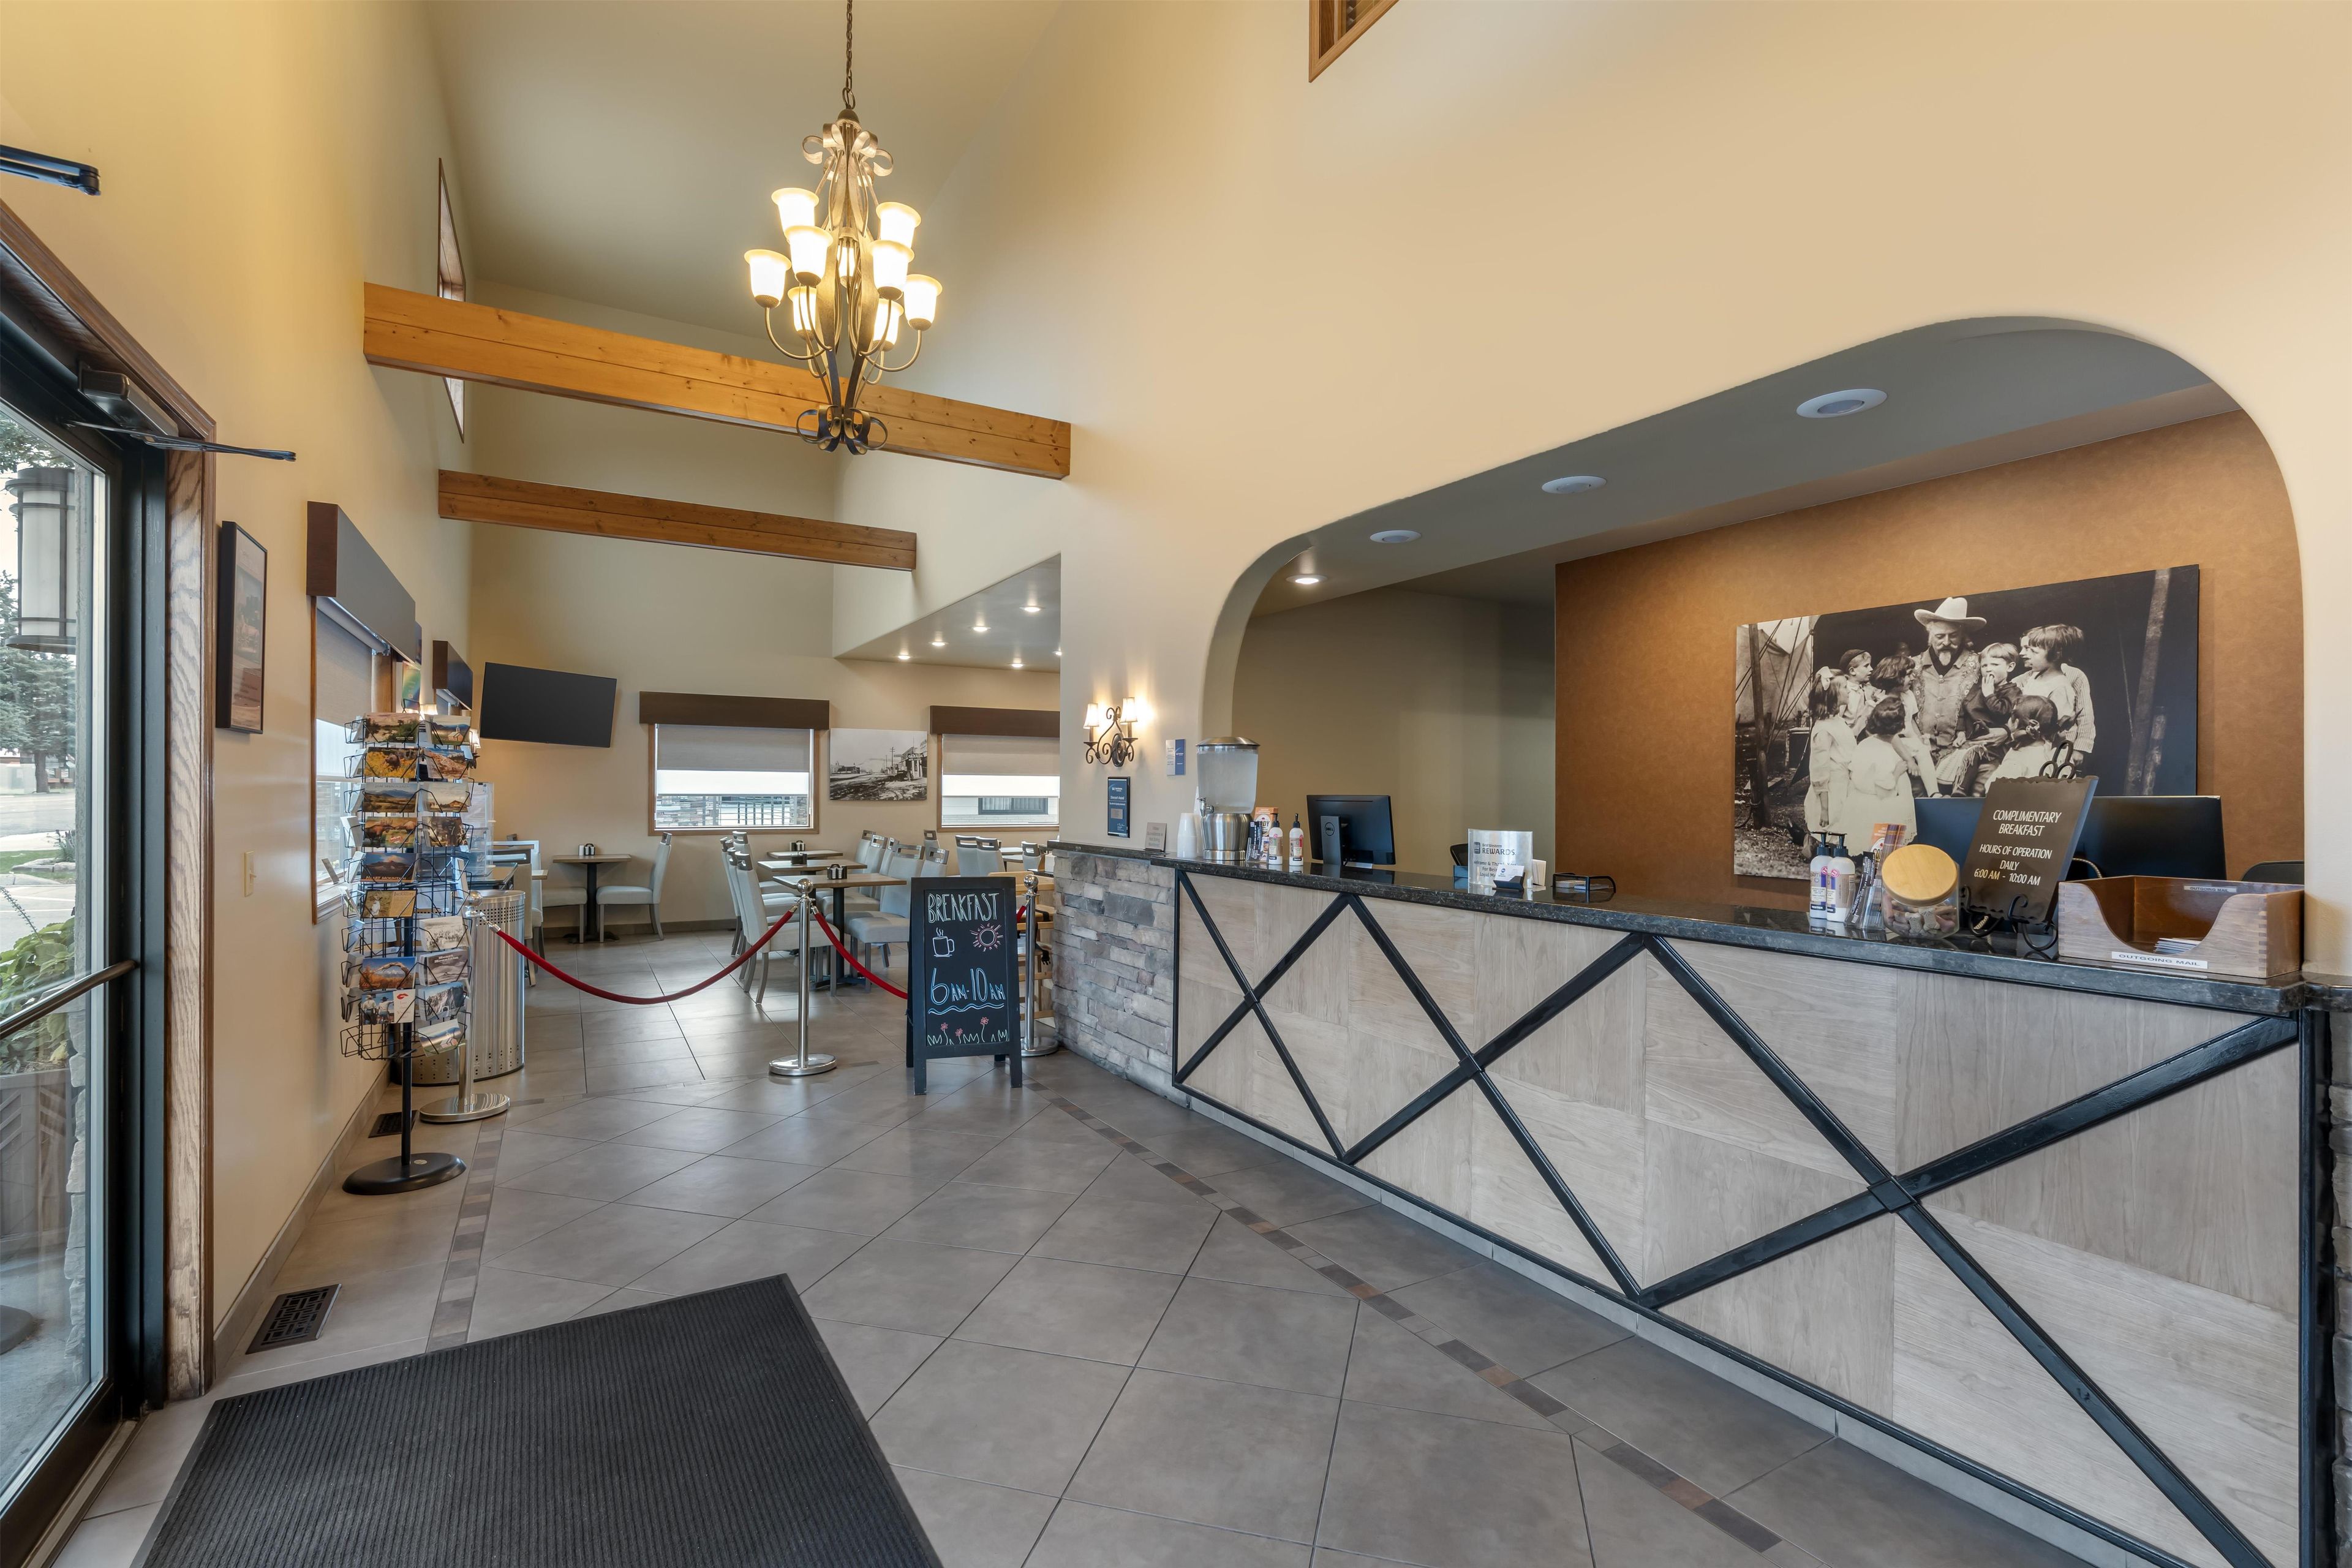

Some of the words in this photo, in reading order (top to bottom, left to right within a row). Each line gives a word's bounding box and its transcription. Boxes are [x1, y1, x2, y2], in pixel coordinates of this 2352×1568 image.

[1993, 809, 2062, 823] COMPLIMENTARY
[1999, 823, 2045, 837] BREAKFAST
[1980, 843, 2001, 855] HOURS
[2002, 846, 2012, 855] OF
[2013, 846, 2052, 859] OPERATION
[2000, 860, 2019, 870] DAILY
[1974, 869, 1988, 878] 6:00
[1988, 870, 2000, 880] AM
[2009, 873, 2027, 884] 10:00
[2027, 875, 2041, 886] AM
[928, 893, 999, 923] BREAKFAST
[2119, 954, 2173, 963] OUTGOING
